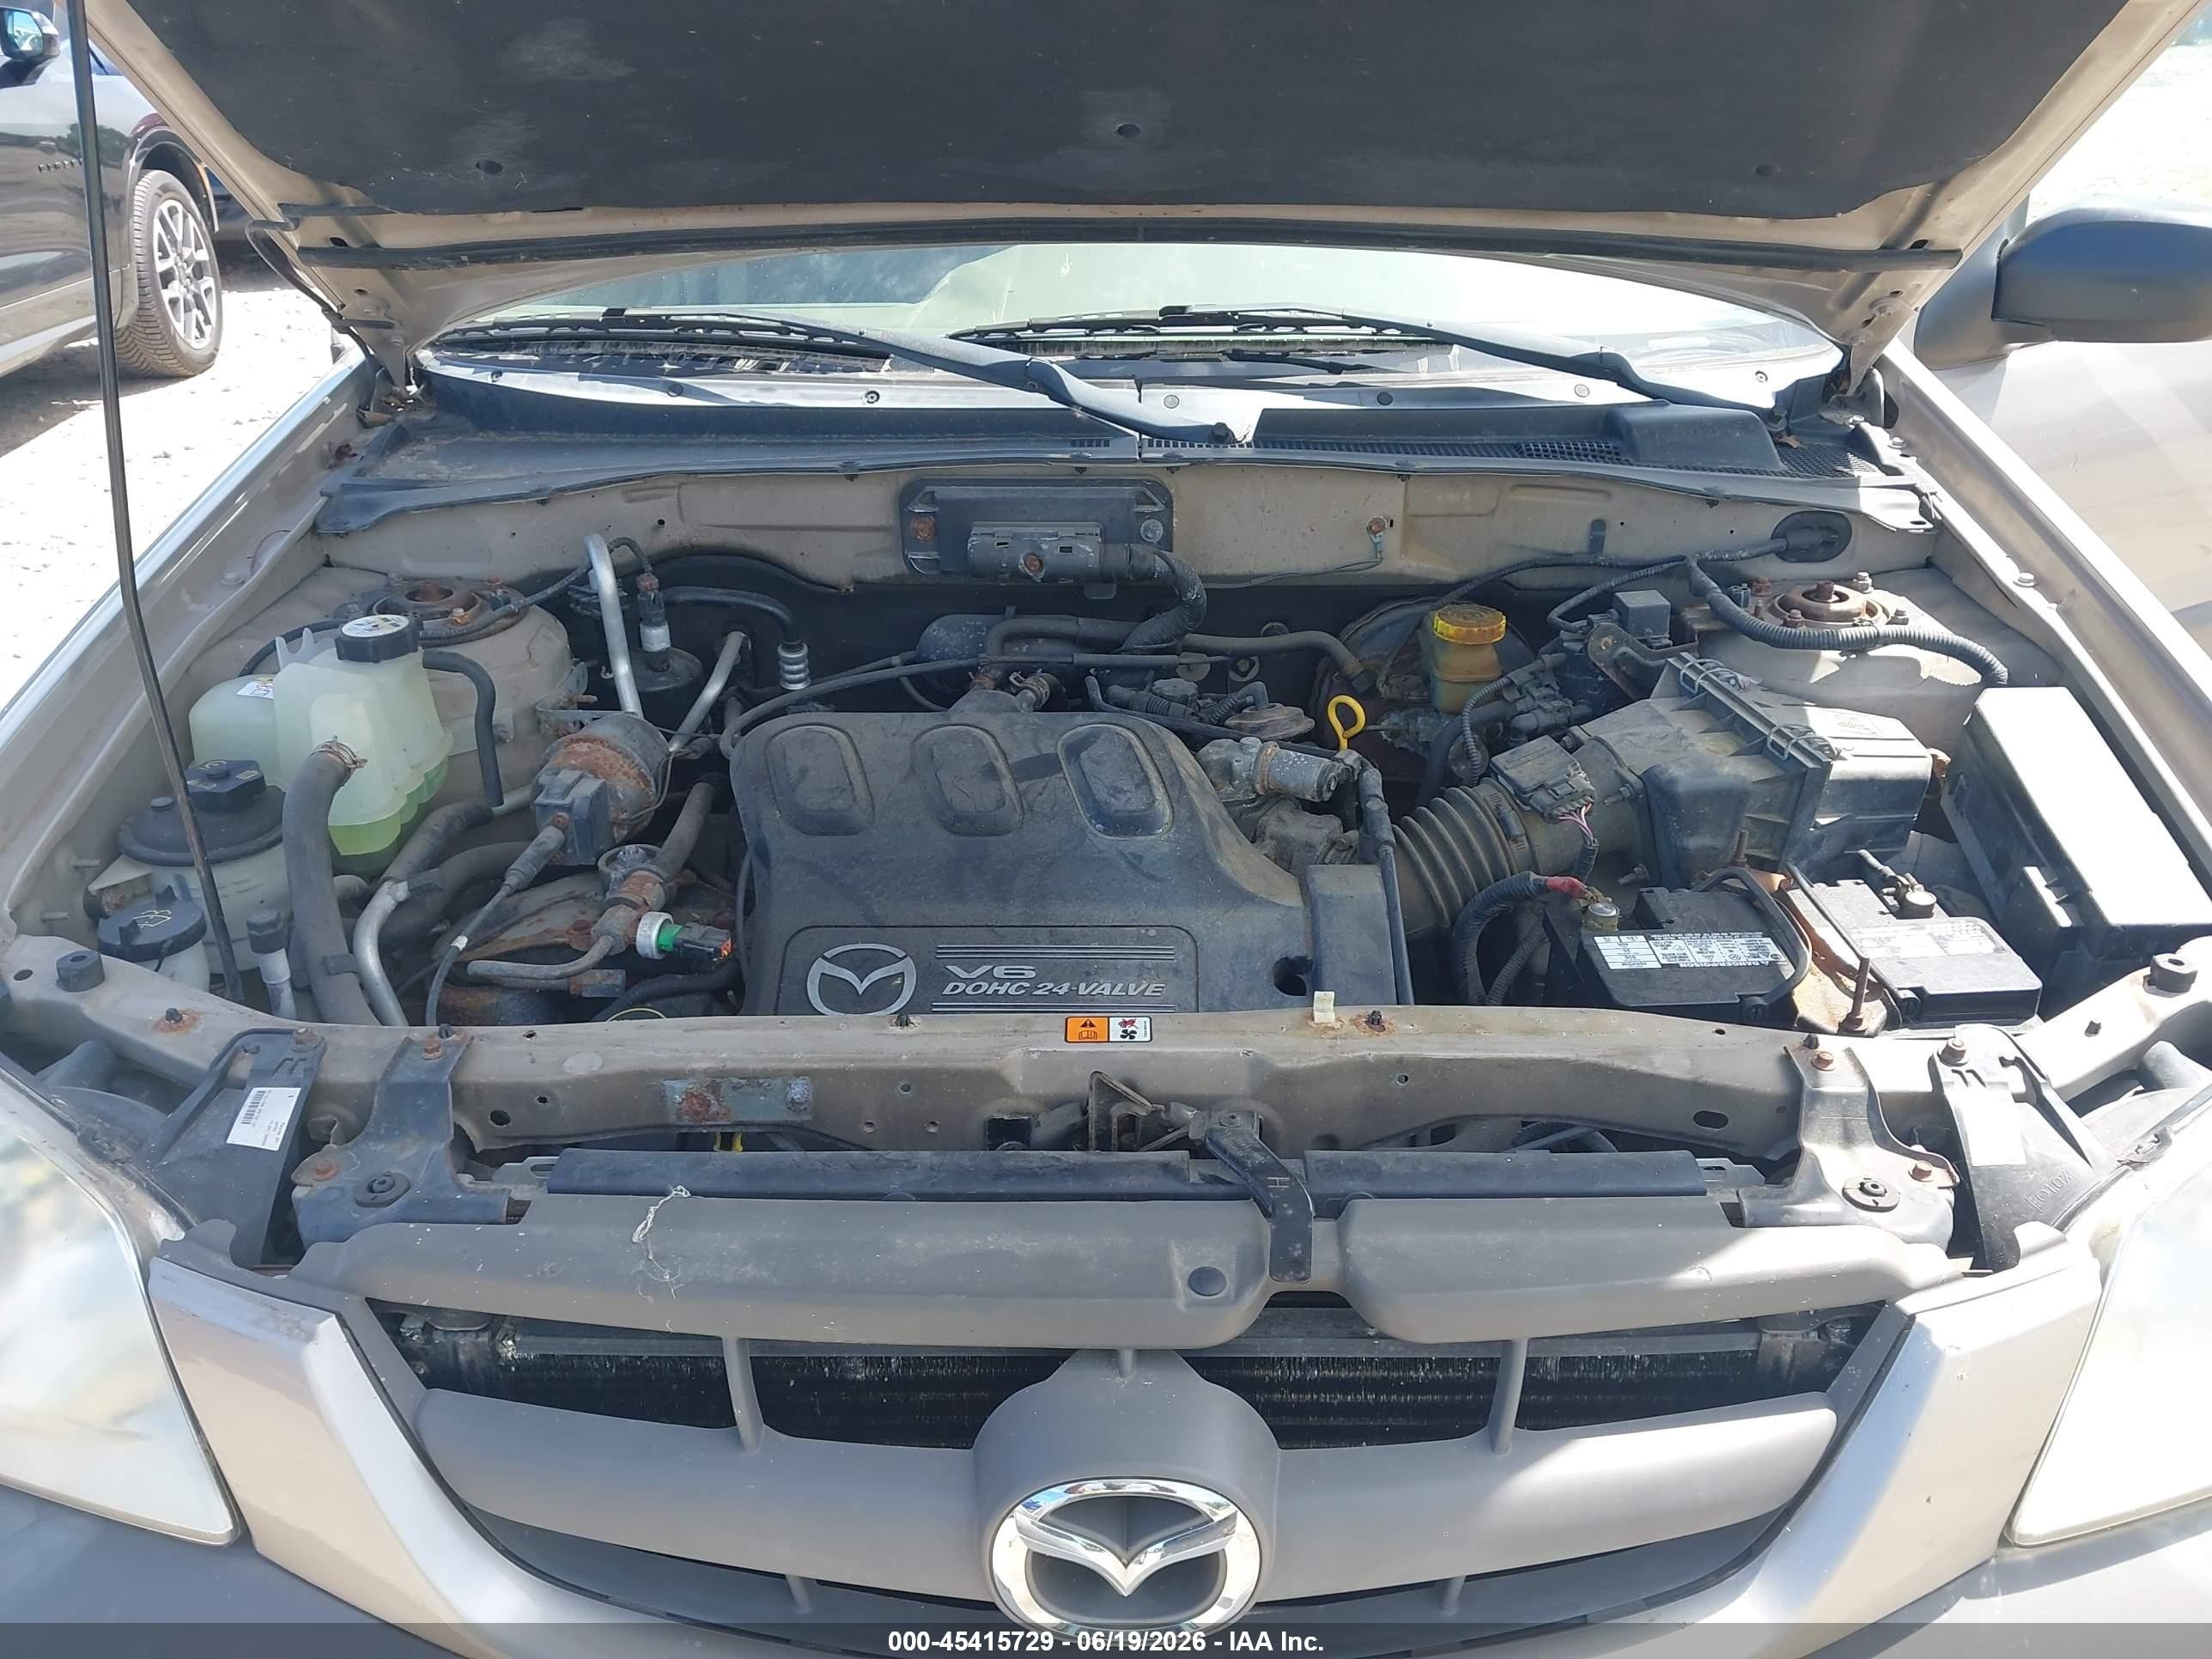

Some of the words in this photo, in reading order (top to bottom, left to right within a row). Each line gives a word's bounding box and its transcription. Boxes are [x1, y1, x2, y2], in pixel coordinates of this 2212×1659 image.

[945, 965, 1036, 979] V6
[941, 981, 1030, 995] DOHC
[1032, 982, 1166, 996] 24-VALVE
